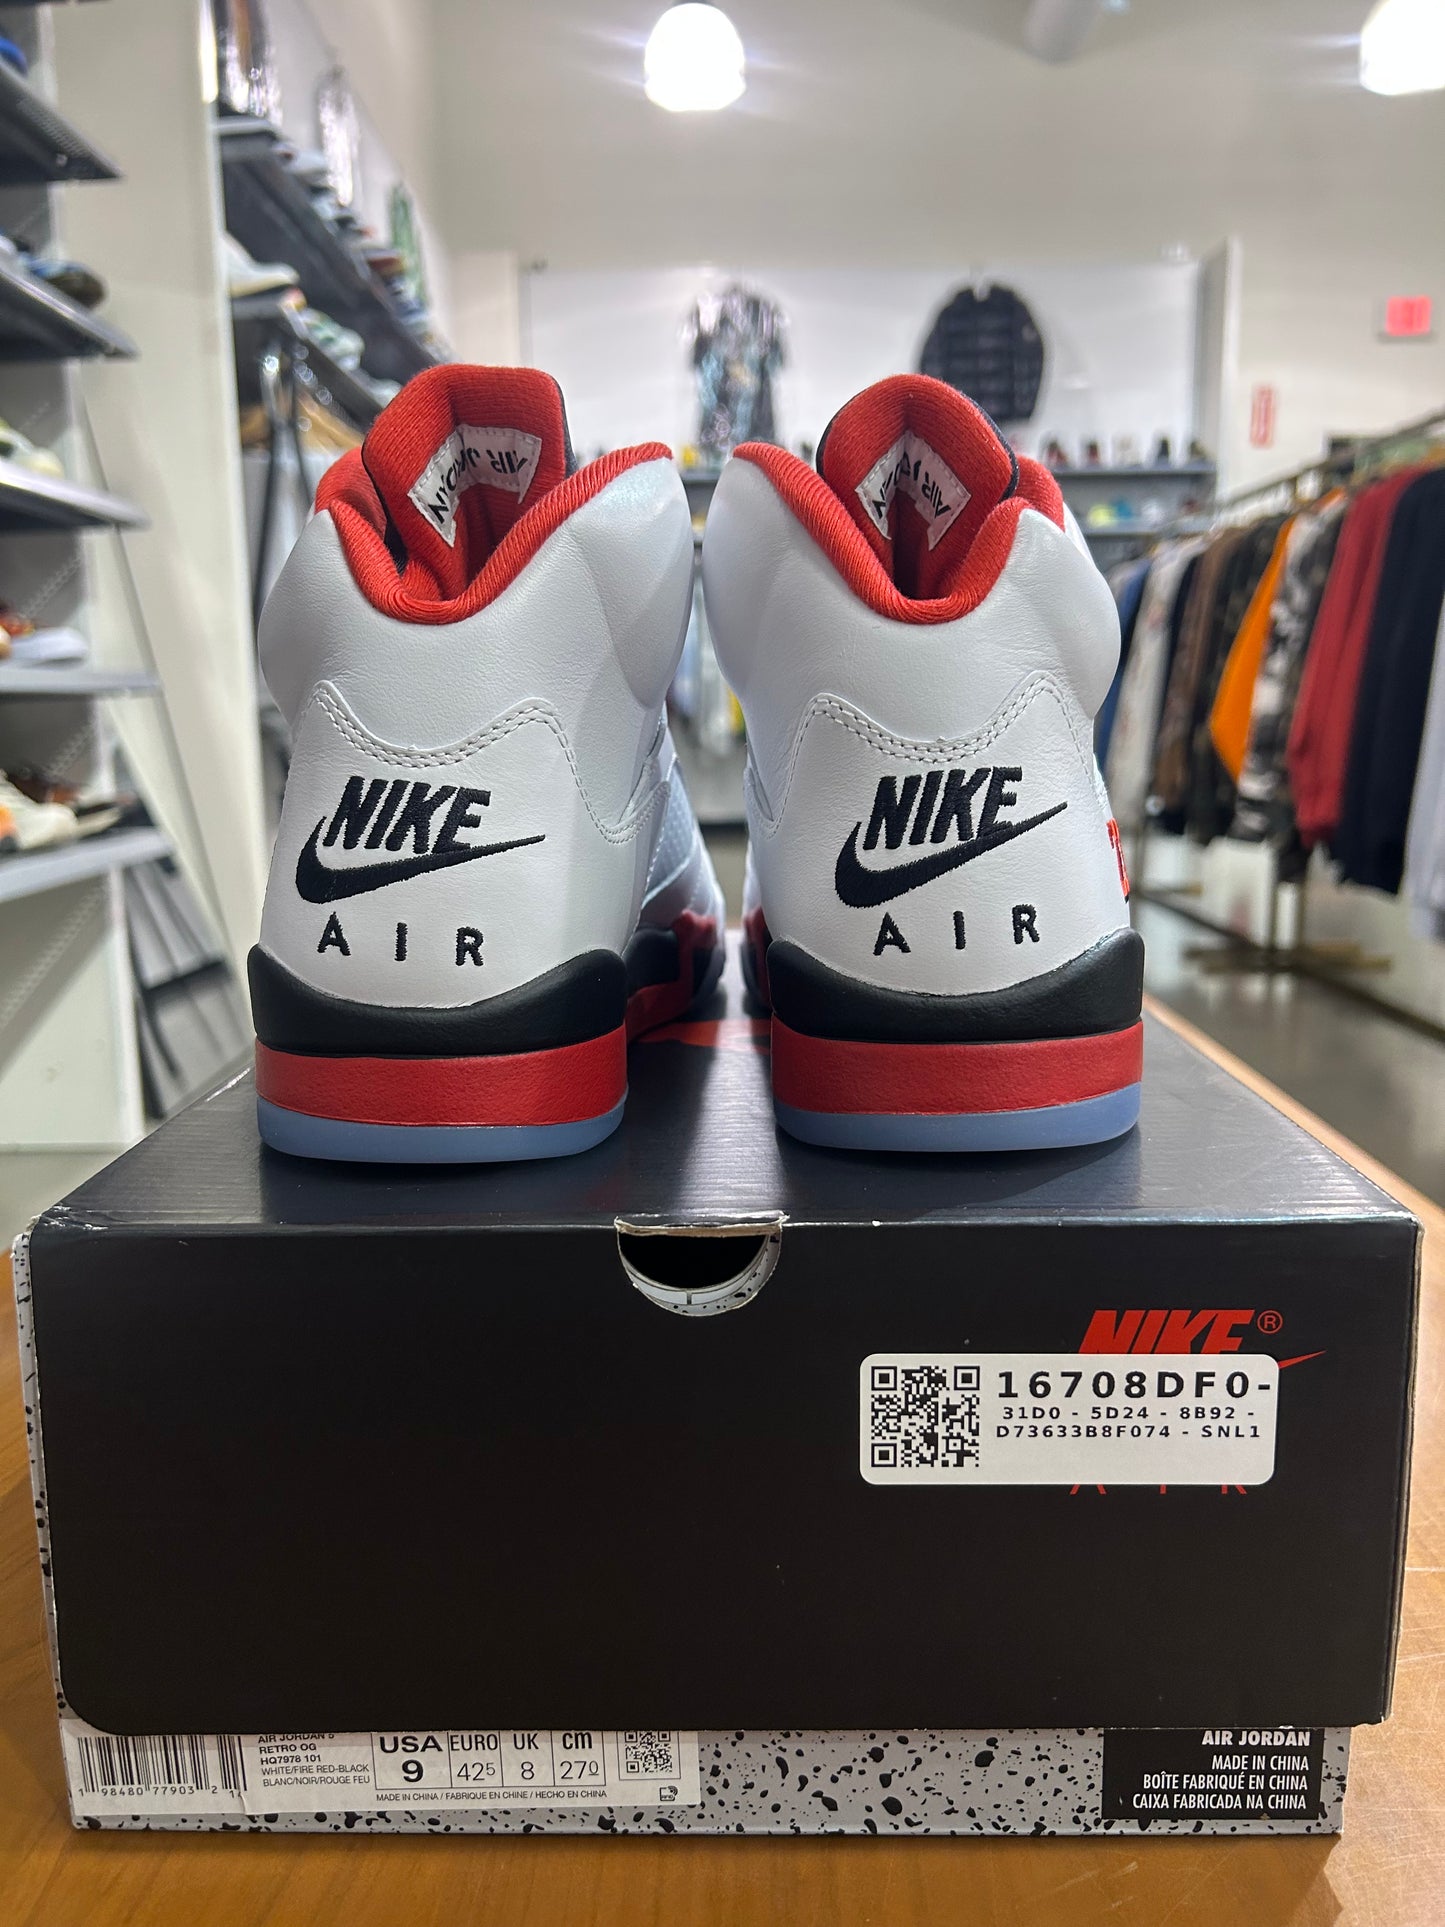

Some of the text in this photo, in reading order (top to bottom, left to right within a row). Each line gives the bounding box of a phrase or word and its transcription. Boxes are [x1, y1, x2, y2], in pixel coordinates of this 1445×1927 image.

[322, 776, 491, 854] NIKE
[862, 766, 1023, 850] NIKE
[873, 904, 1040, 956] AIR
[316, 911, 485, 967] AIR
[998, 1371, 1271, 1399] 16708DF0-
[1003, 1406, 1060, 1420] 31D0
[1091, 1406, 1149, 1420] 5D24
[1179, 1406, 1235, 1420] 8B92
[996, 1425, 1170, 1438] D73633B8F074
[1201, 1425, 1260, 1438] SNL1
[258, 1734, 277, 1743] AIR
[379, 1732, 592, 1753] USA EURO UK cm
[1201, 1730, 1311, 1747] AIR JORDAN
[259, 1743, 317, 1754] RETRO OG
[260, 1754, 321, 1765] HQ7978 101
[1212, 1754, 1309, 1771] MADE IN CHINA
[261, 1764, 370, 1776] WHITE/FIRE RED-BLACK
[402, 1759, 424, 1782] 9
[521, 1761, 535, 1780] 8
[263, 1775, 370, 1787] BLANC/NOIR/ROUGE FEU
[1143, 1770, 1308, 1790] BOÎTE FABRIQUÉ EN CHINA
[78, 1788, 84, 1797] 1
[101, 1786, 144, 1796] 98480
[152, 1786, 195, 1795] 77903
[211, 1785, 218, 1794] 2
[376, 1793, 400, 1801] MADE
[445, 1791, 487, 1800] FABRIQUE
[489, 1791, 500, 1799] EN
[502, 1791, 528, 1799] CHINE
[535, 1790, 565, 1799] HECHO
[567, 1790, 578, 1798] EN
[580, 1790, 607, 1798] CHINA
[1132, 1793, 1306, 1809] CAIXA FABRICADA NA CHINA
